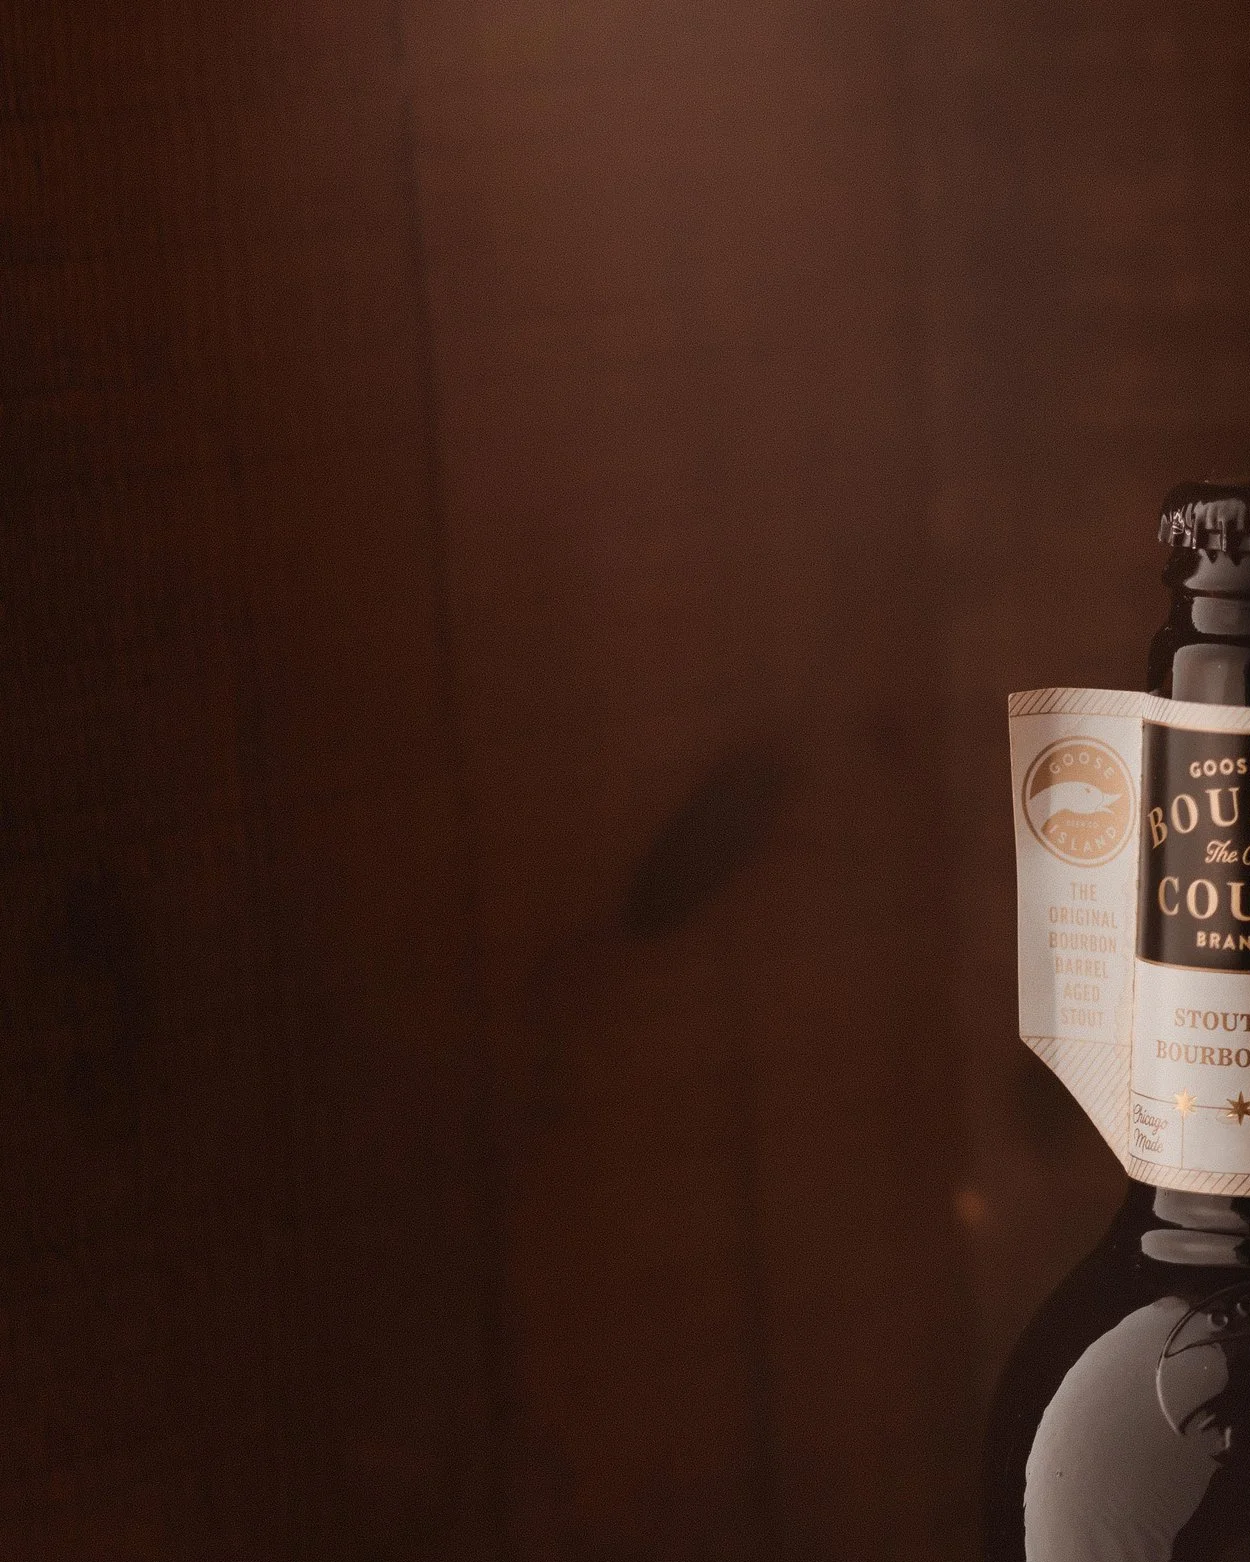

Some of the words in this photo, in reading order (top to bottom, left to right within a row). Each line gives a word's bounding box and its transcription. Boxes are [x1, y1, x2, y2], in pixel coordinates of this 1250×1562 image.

[1049, 751, 1115, 780] GOOSE
[1048, 823, 1117, 853] ISLAND
[1204, 840, 1238, 864] The
[1070, 882, 1097, 902] THE
[1049, 906, 1118, 929] ORIGINAL
[1048, 931, 1117, 954] BOURBON
